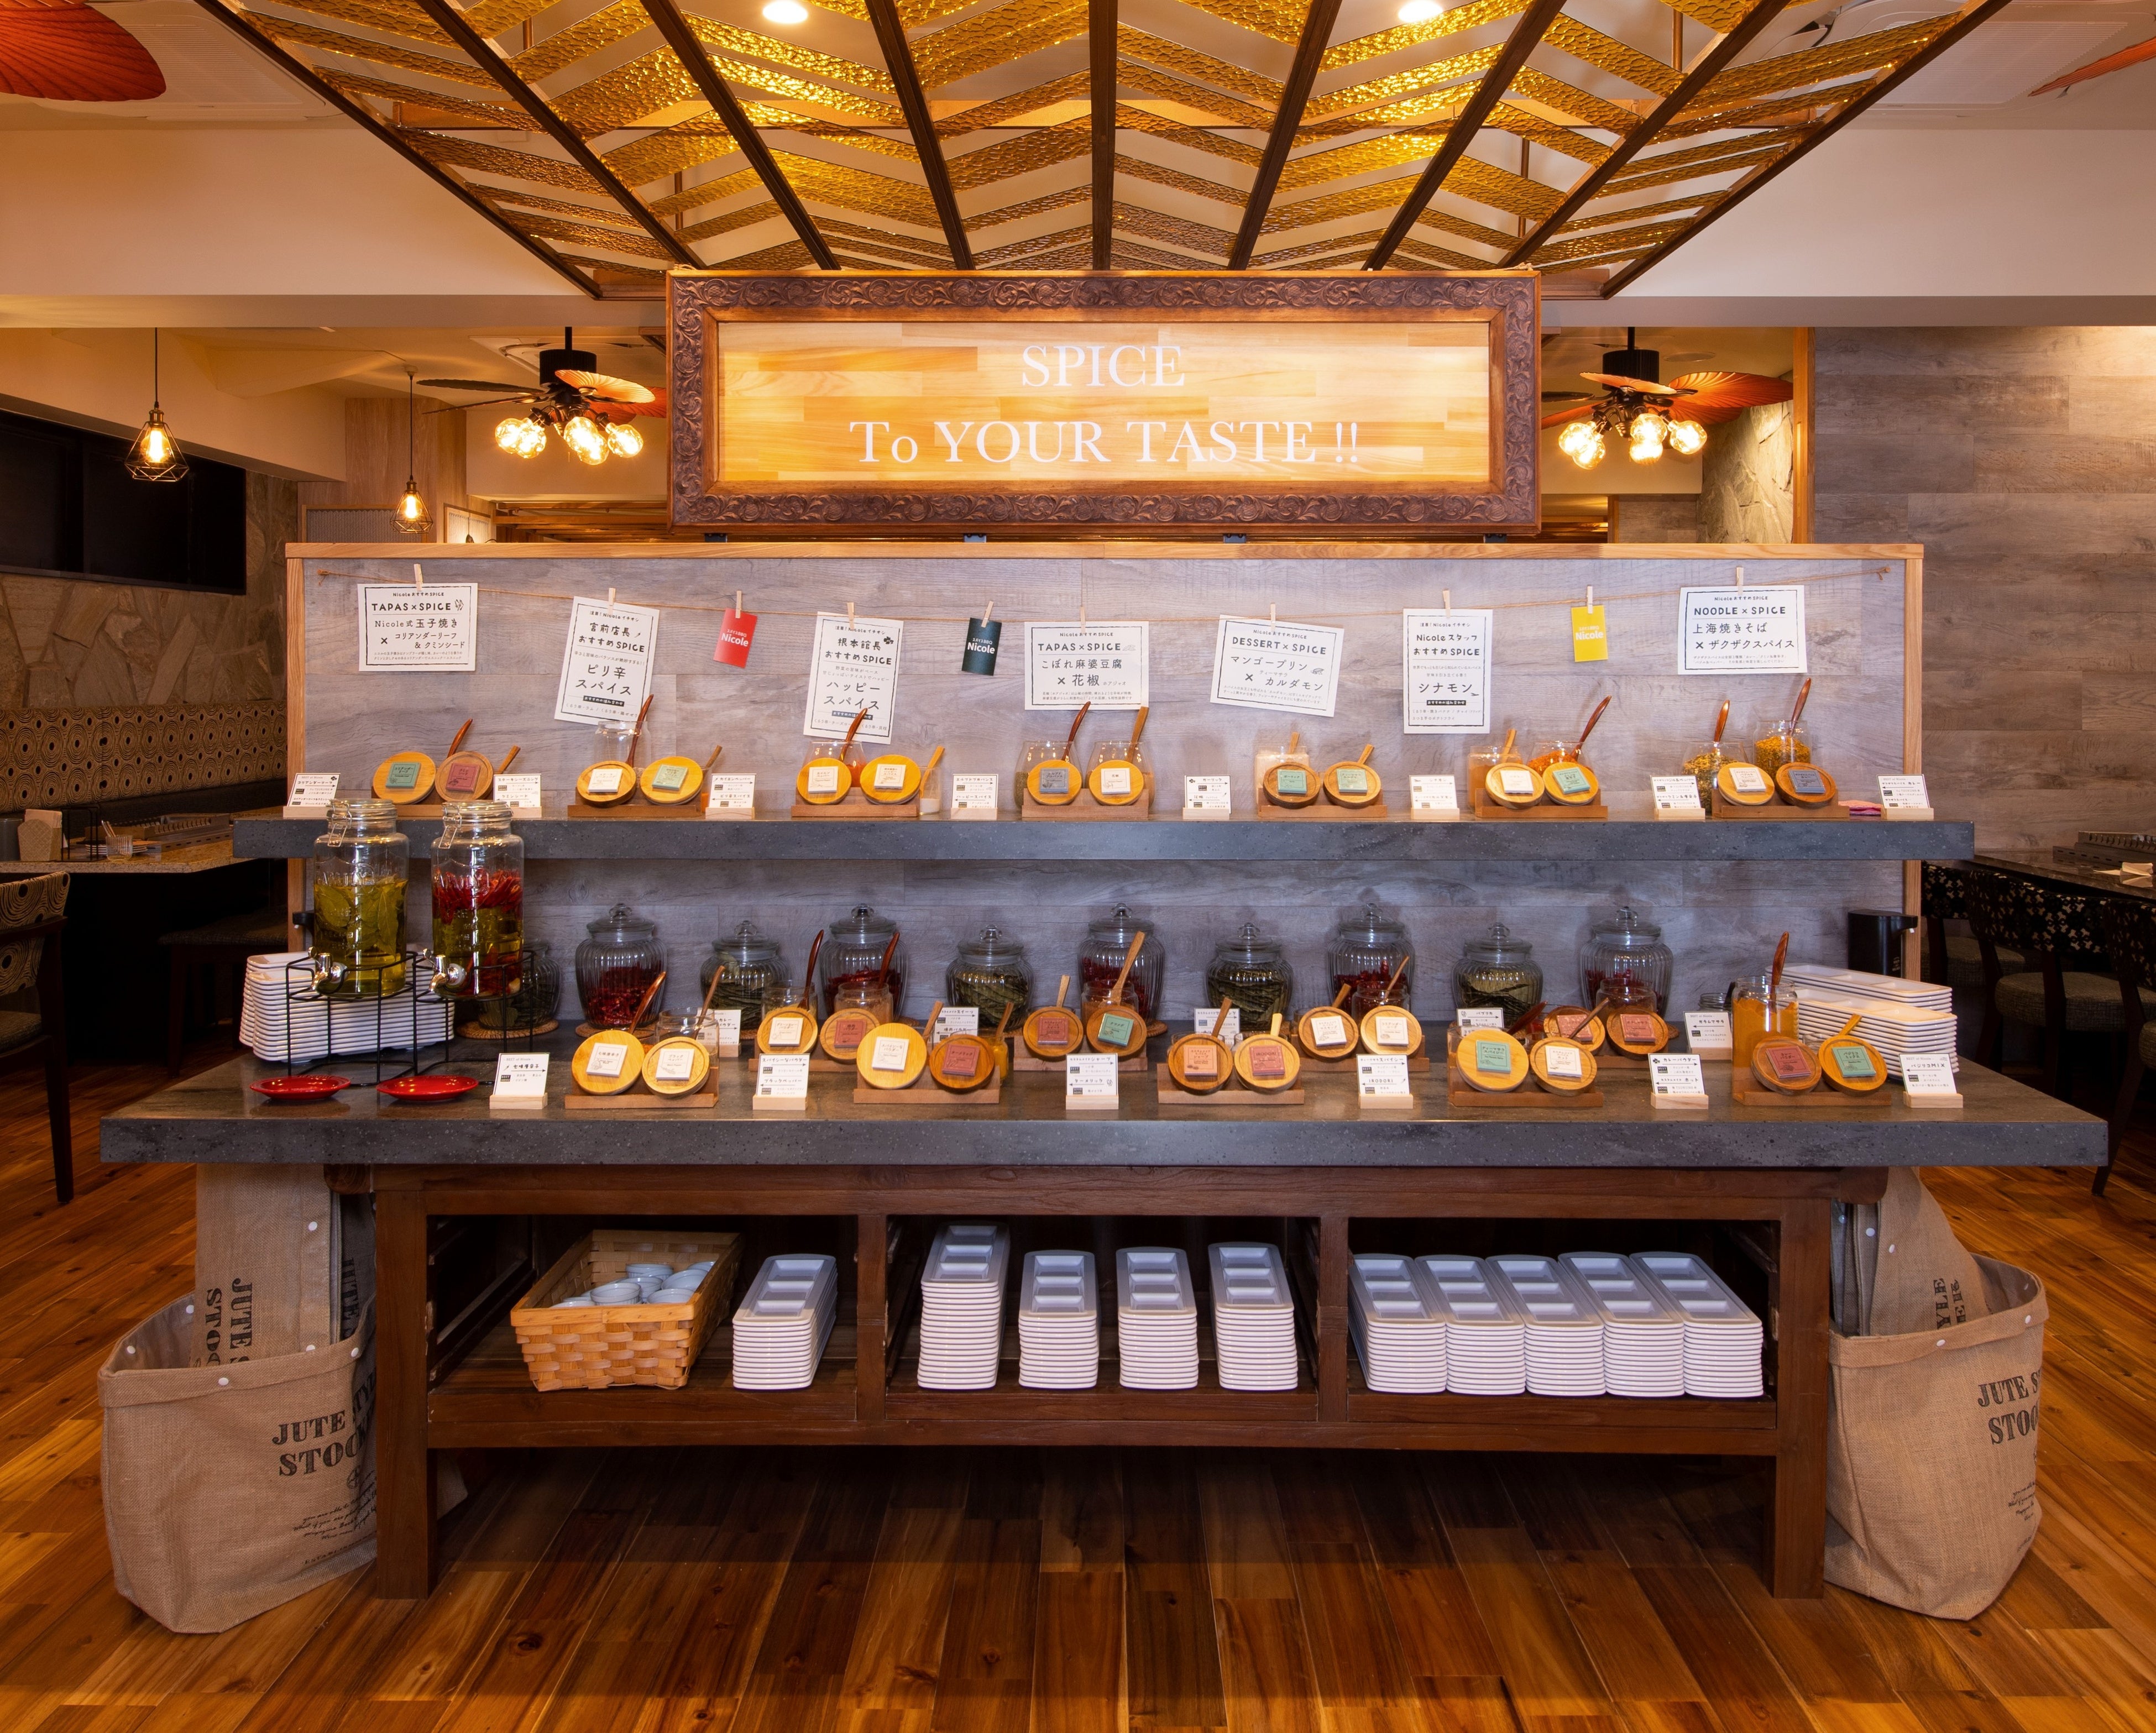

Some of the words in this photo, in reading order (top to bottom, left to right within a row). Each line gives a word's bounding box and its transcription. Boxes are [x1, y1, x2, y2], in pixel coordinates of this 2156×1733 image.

[1022, 345, 1185, 387] SPICE
[850, 422, 918, 463] To
[934, 421, 1111, 462] YOUR
[1127, 421, 1316, 462] TASTE
[1336, 422, 1358, 463] !!
[590, 622, 630, 637] 宮前店長
[1576, 630, 1604, 640] Nicole
[1693, 622, 1767, 634] 上海焼きそば
[721, 633, 749, 647] Nicole
[838, 637, 881, 651] 根本館長
[1709, 639, 1794, 650] ザクザクスパイス
[967, 642, 995, 654] Nicole
[1042, 659, 1122, 669] こぼれ麻婆豆腐
[1231, 656, 1307, 671] マンゴープリン
[588, 664, 626, 679] ピリ辛
[575, 679, 631, 695] スパイス
[827, 682, 880, 692] ハッピー
[1072, 674, 1100, 687] 花椒
[1265, 677, 1323, 691] カルダモン
[1419, 683, 1472, 693] シナモン
[824, 696, 879, 710] スパイス
[230, 1278, 252, 1349] JUTE
[1978, 1375, 2029, 1407] JUTE
[272, 1410, 346, 1445] JUTE
